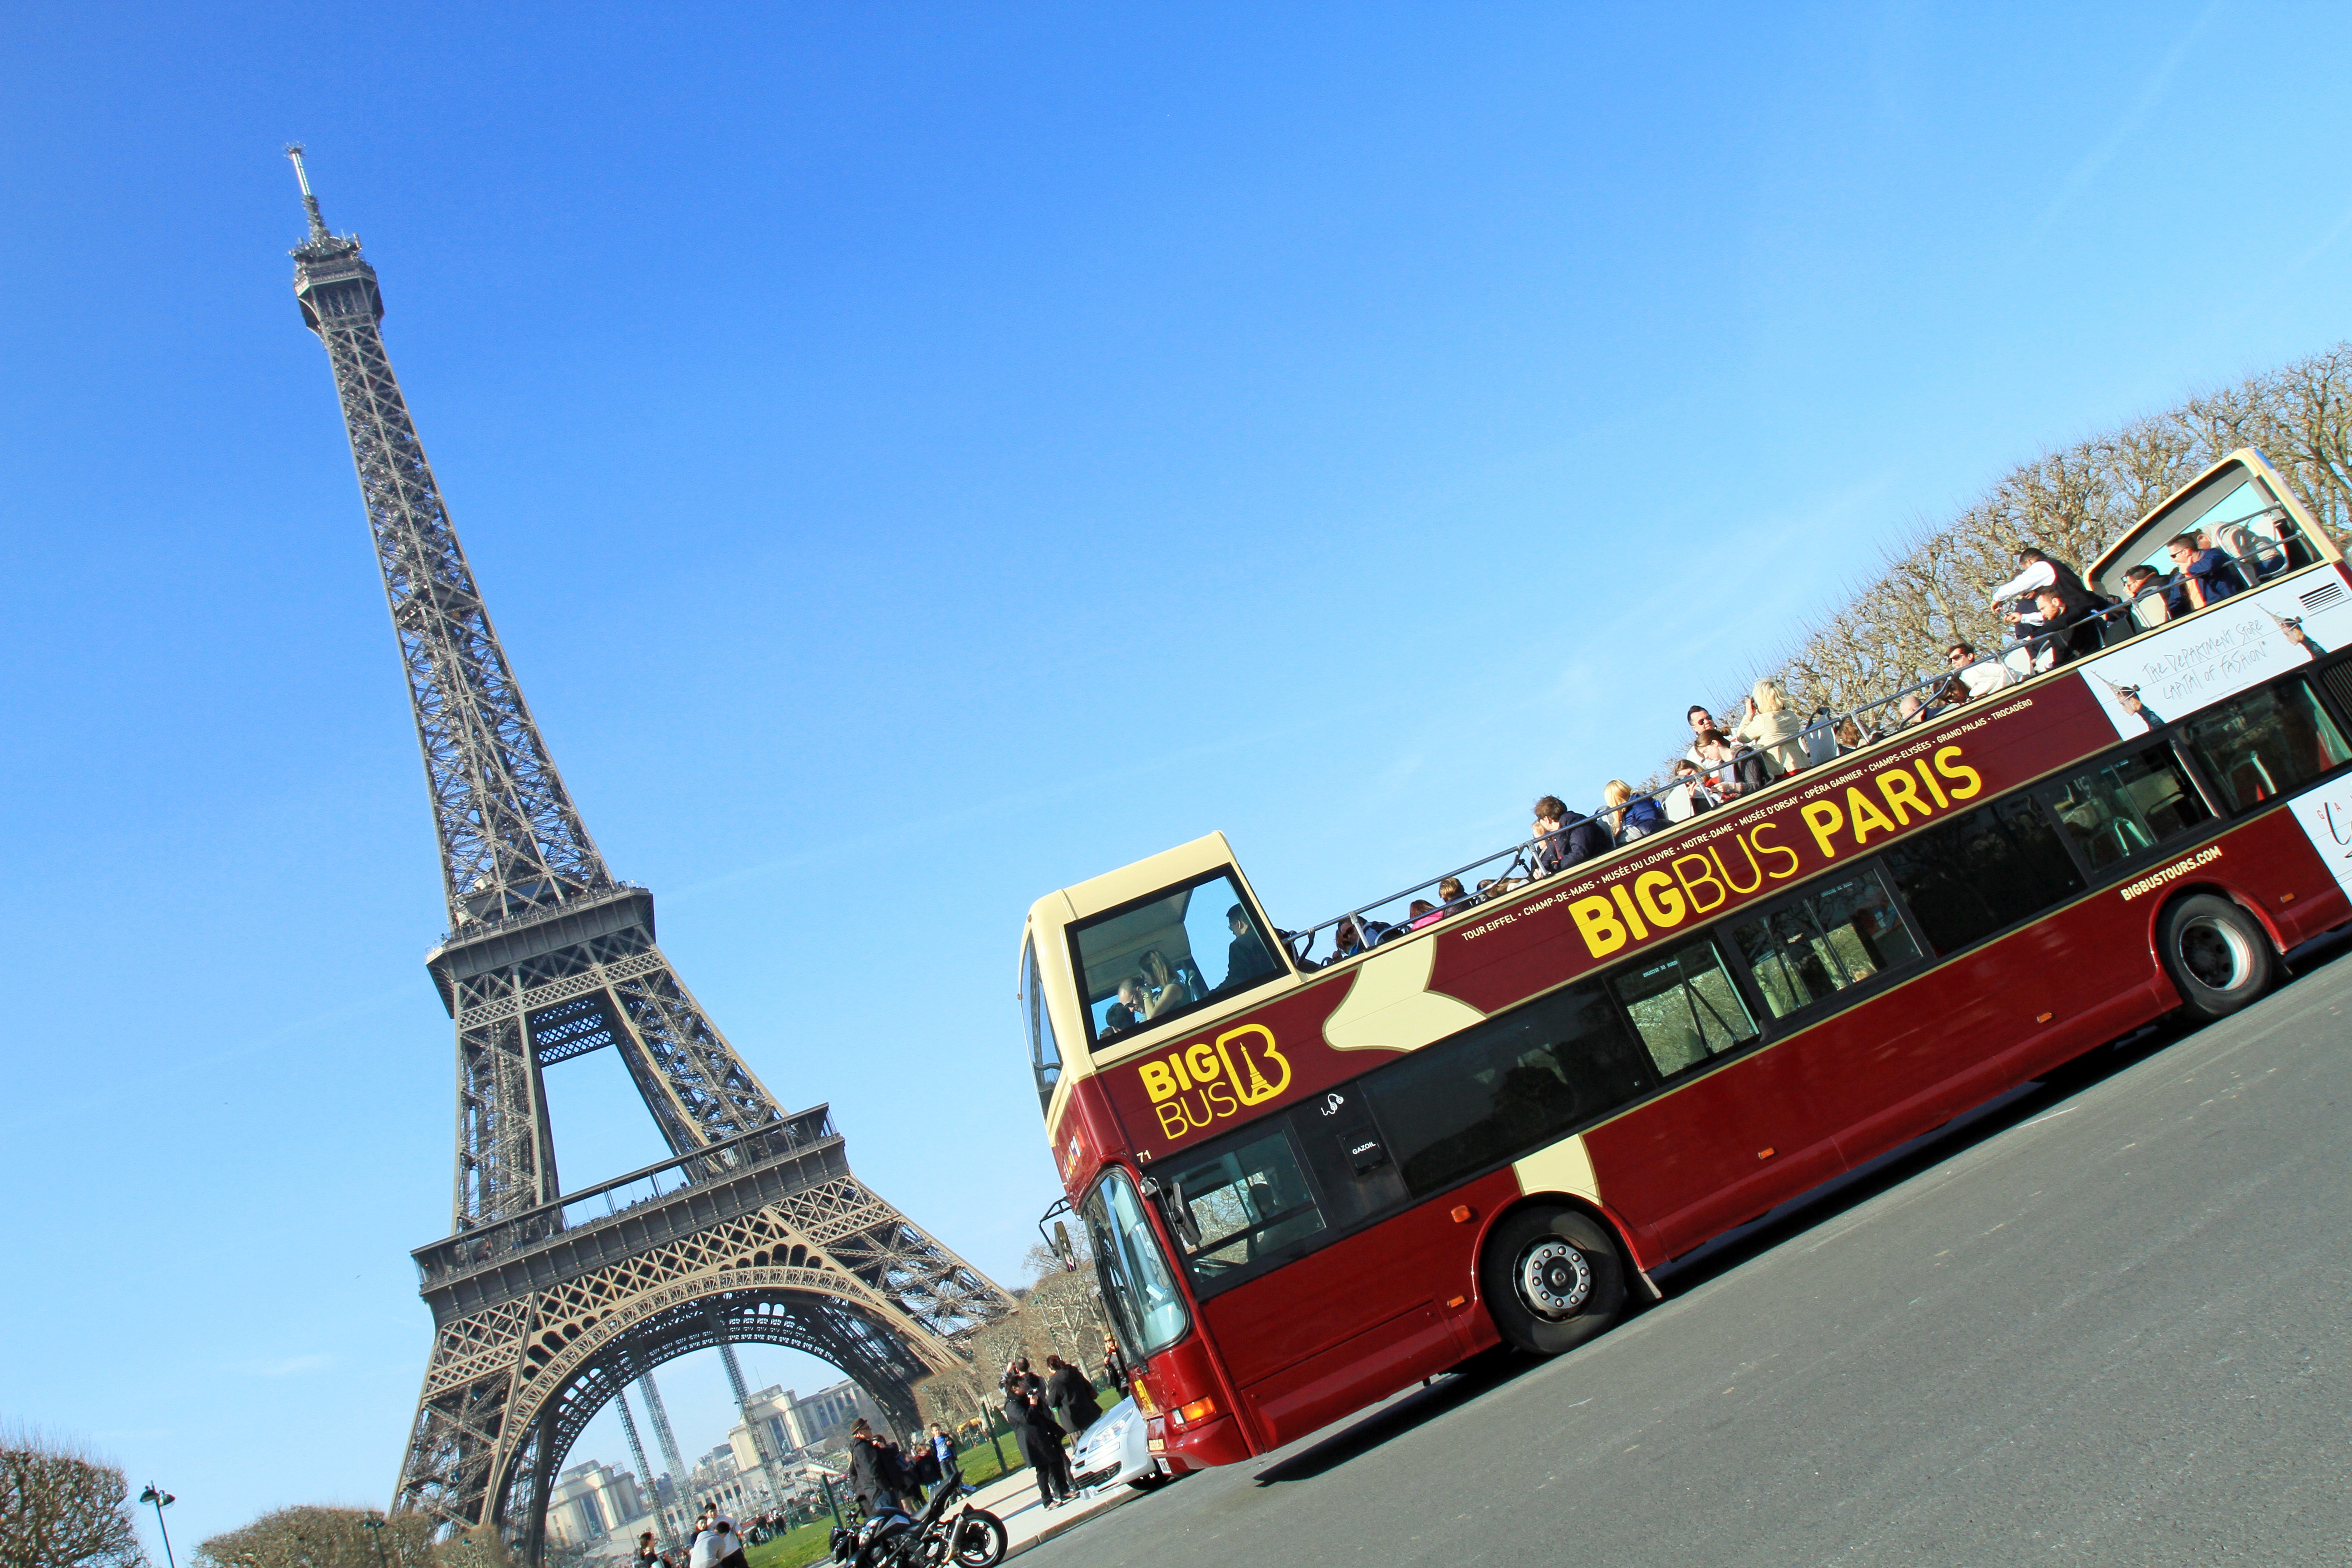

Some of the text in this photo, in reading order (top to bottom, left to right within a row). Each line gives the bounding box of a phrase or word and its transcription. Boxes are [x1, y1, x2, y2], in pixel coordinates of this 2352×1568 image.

[1461, 699, 2033, 941] TOUR EIFFEL CHAMP-DE-MARS MUSÉE DU LOUVRE NOTRE-DAME MUSÉE D'ORSAY OPÉRA GARNIER CHAMPS-ELYSÉES GRAND PALAIS TROCADÉRO
[1801, 746, 1982, 858] PARIS
[2120, 845, 2222, 901] BIGBUSTOURS.COM
[1138, 1044, 1220, 1103] BIG
[1156, 1082, 1237, 1140] BUS
[1136, 1150, 1152, 1163] 71
[1352, 1142, 1376, 1154] GAZOIL
